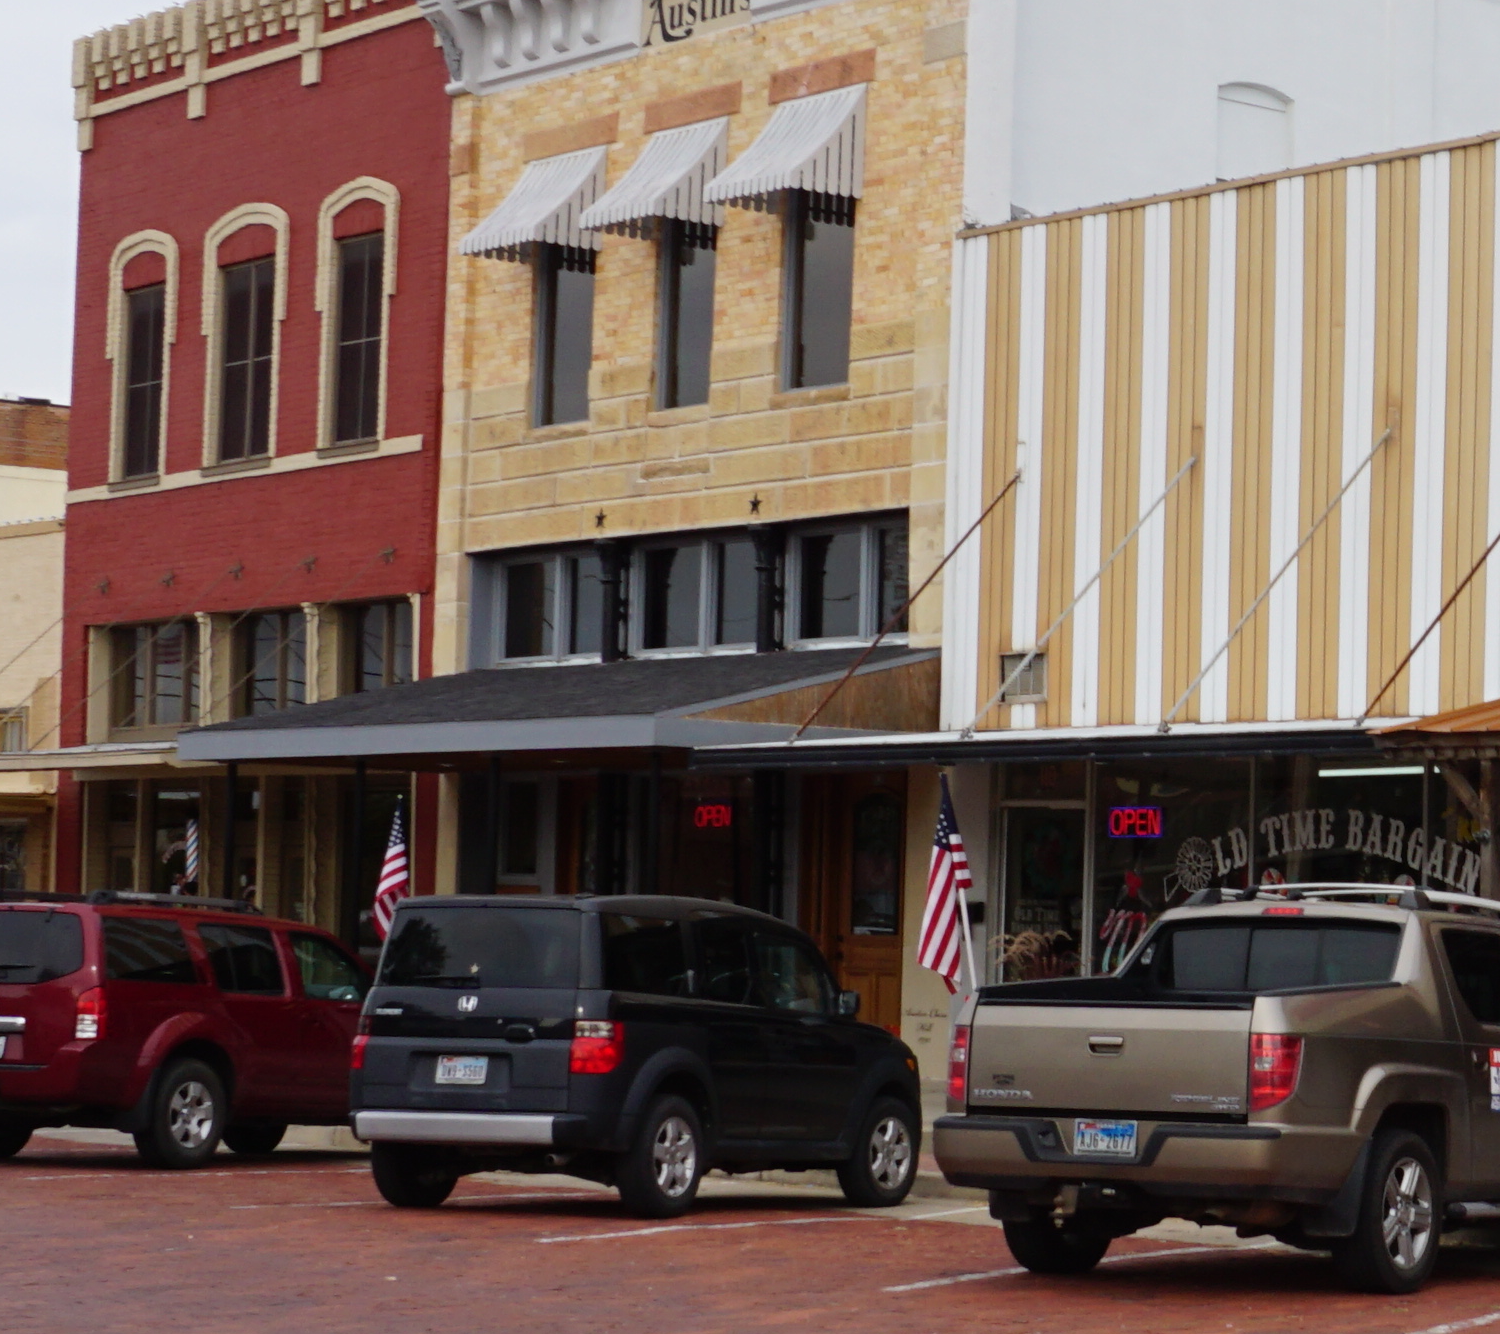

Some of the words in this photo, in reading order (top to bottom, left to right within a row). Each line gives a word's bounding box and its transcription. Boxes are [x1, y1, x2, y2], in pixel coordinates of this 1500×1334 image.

[694, 804, 732, 828] OPEN
[1111, 808, 1162, 836] OPEN
[1259, 808, 1335, 859] TIME
[1345, 808, 1482, 898] BARGAIN
[974, 1088, 1034, 1100] HONDA
